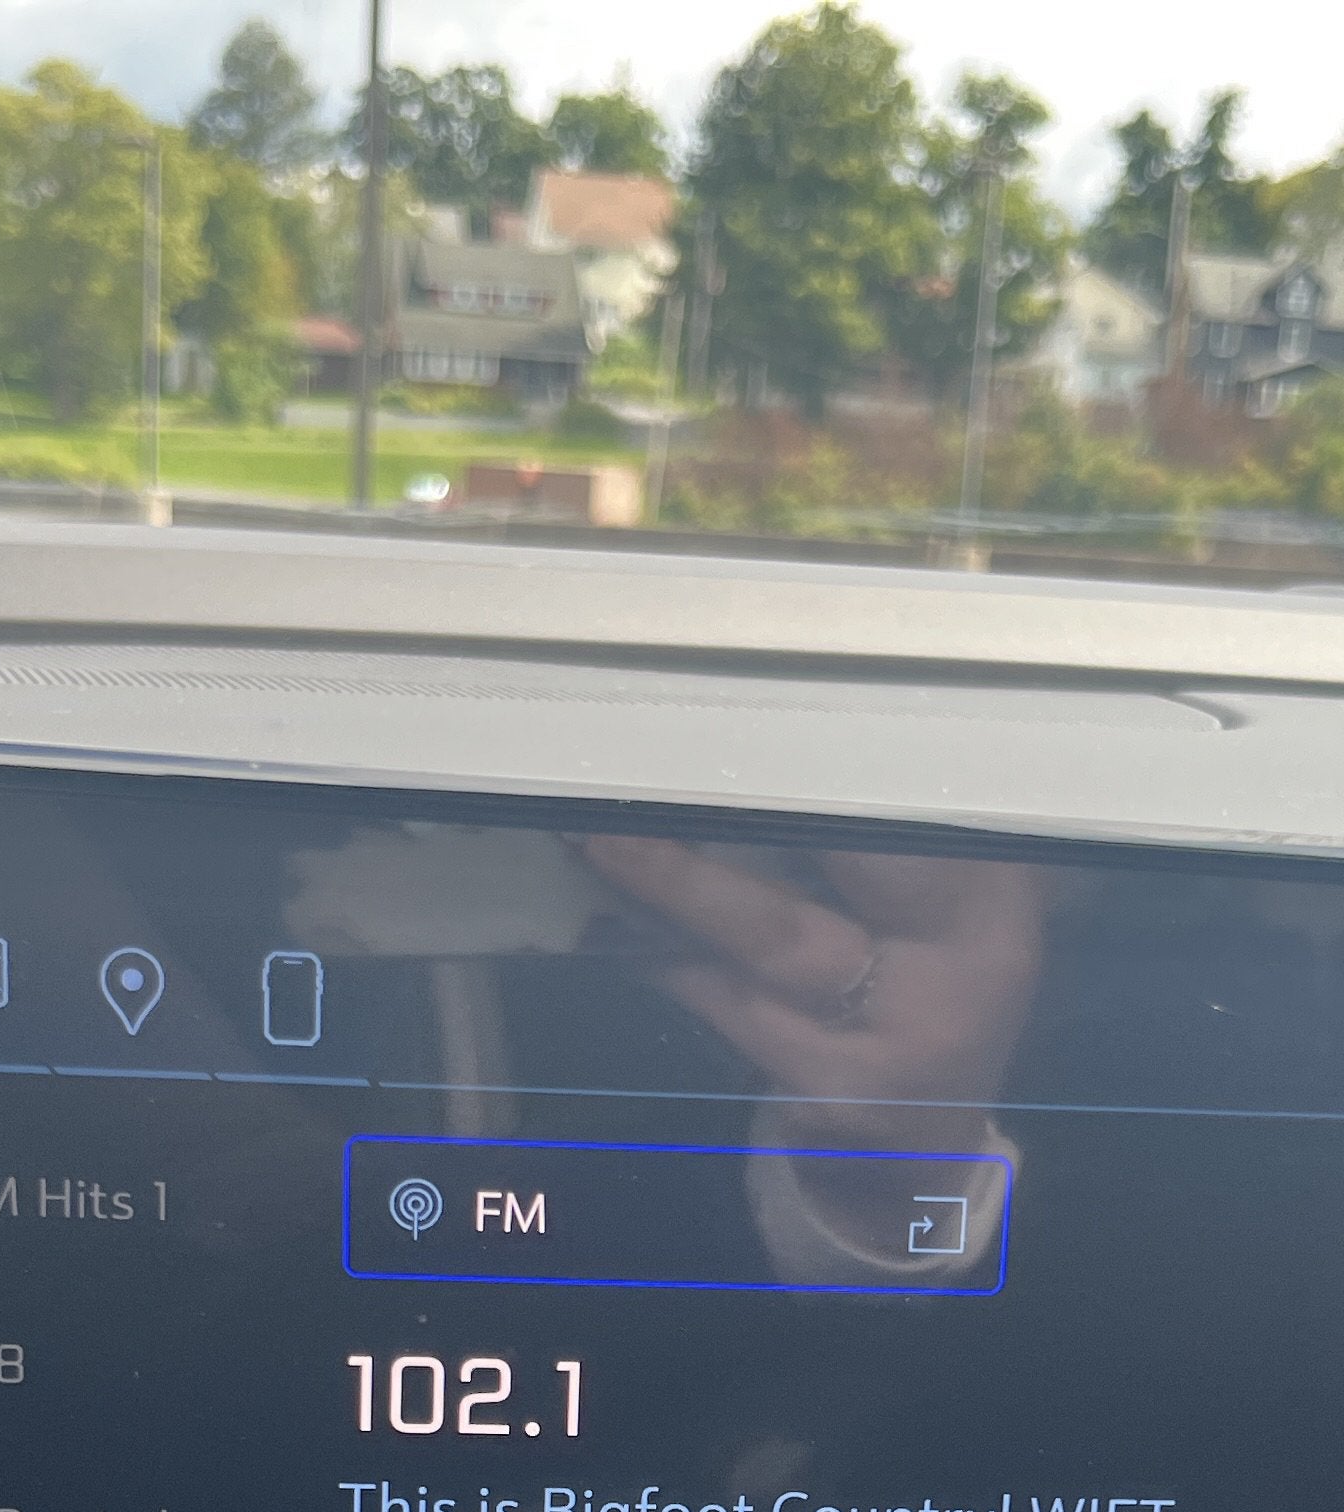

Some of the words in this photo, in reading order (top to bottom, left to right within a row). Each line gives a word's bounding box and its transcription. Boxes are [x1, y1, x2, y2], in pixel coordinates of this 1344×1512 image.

[37, 1177, 136, 1220] Hits
[153, 1180, 169, 1222] 1
[474, 1190, 547, 1236] FM
[346, 1353, 585, 1439] 102.1
